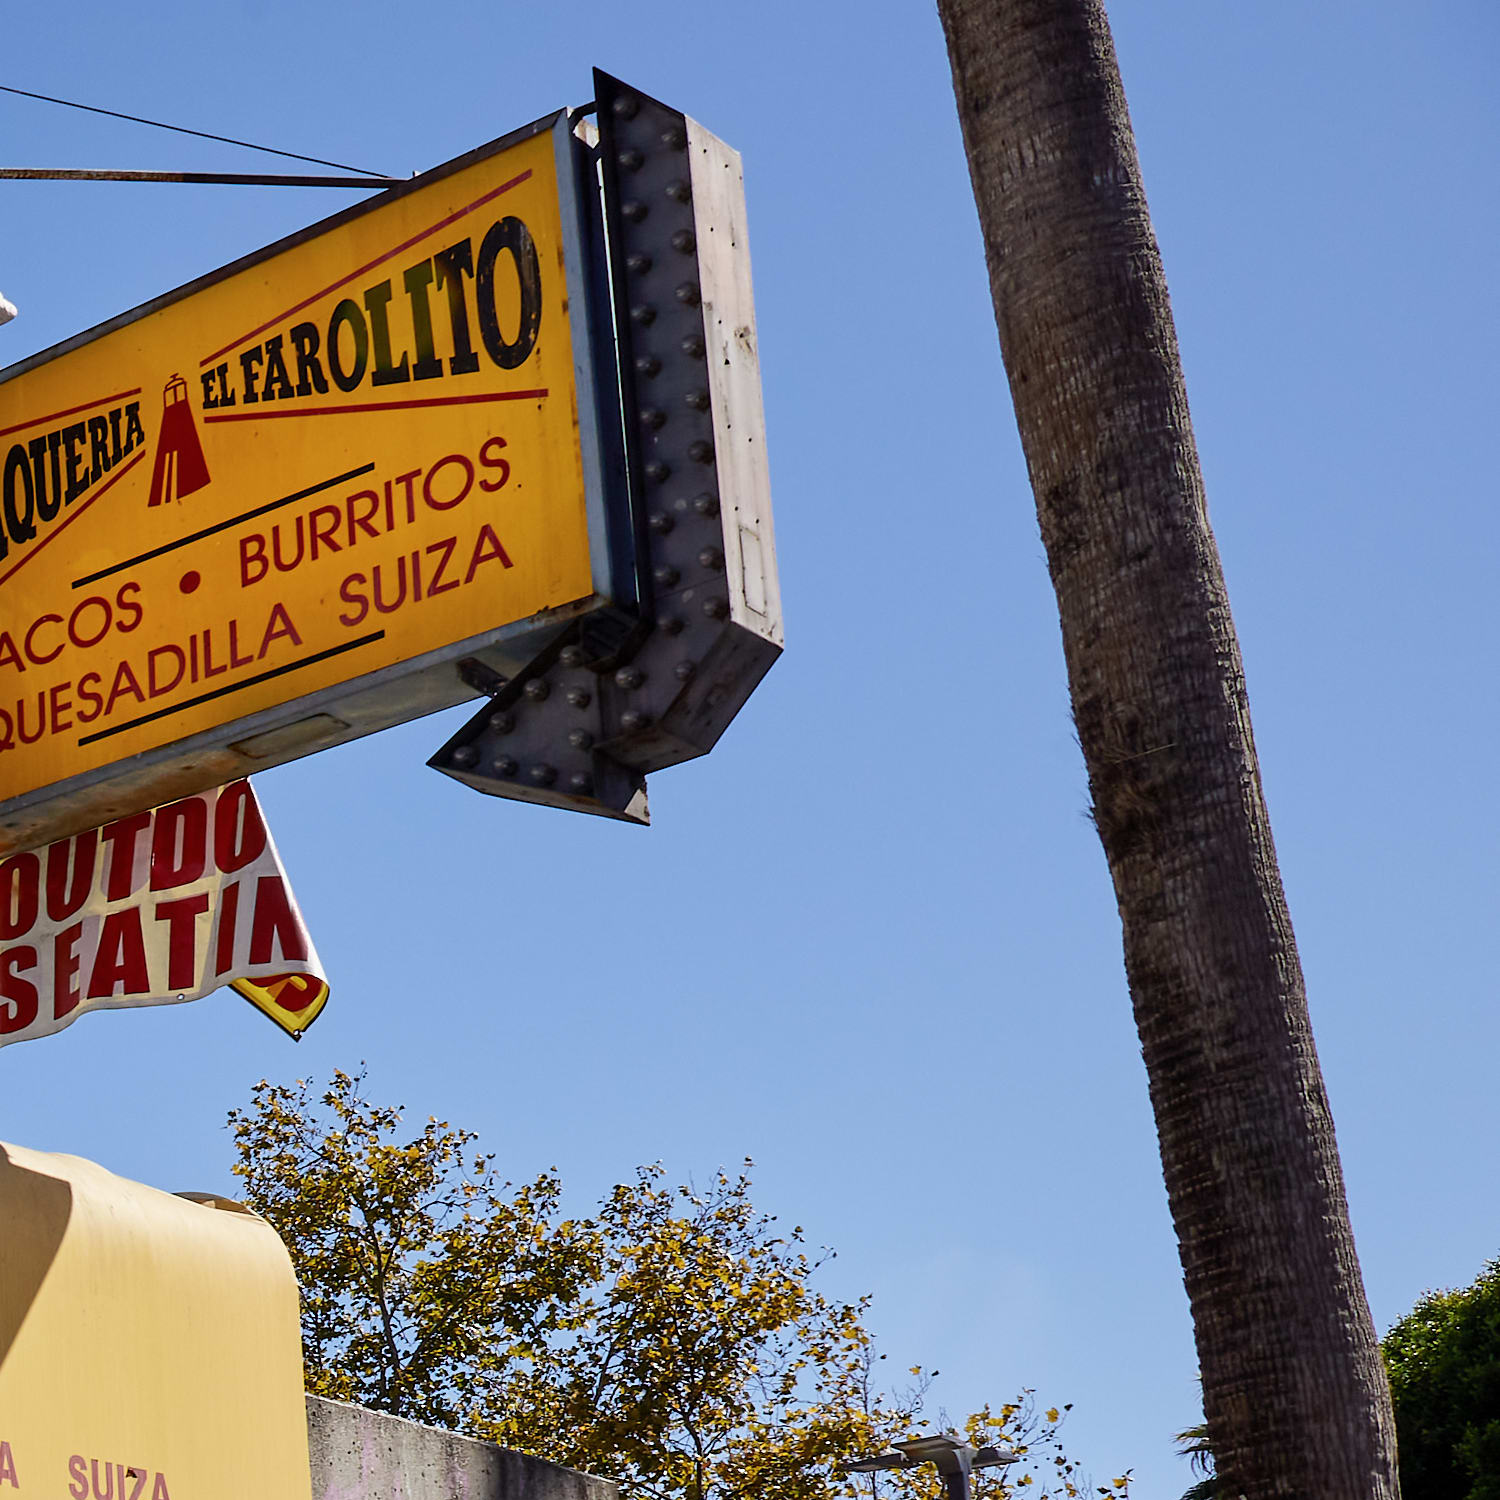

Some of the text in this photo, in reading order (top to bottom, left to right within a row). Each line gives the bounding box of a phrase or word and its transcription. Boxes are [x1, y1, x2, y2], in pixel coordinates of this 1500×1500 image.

[200, 363, 236, 410] EL
[240, 215, 543, 404] FAROLITO
[238, 436, 512, 588] BURRITOS
[339, 523, 514, 627] SUIZA
